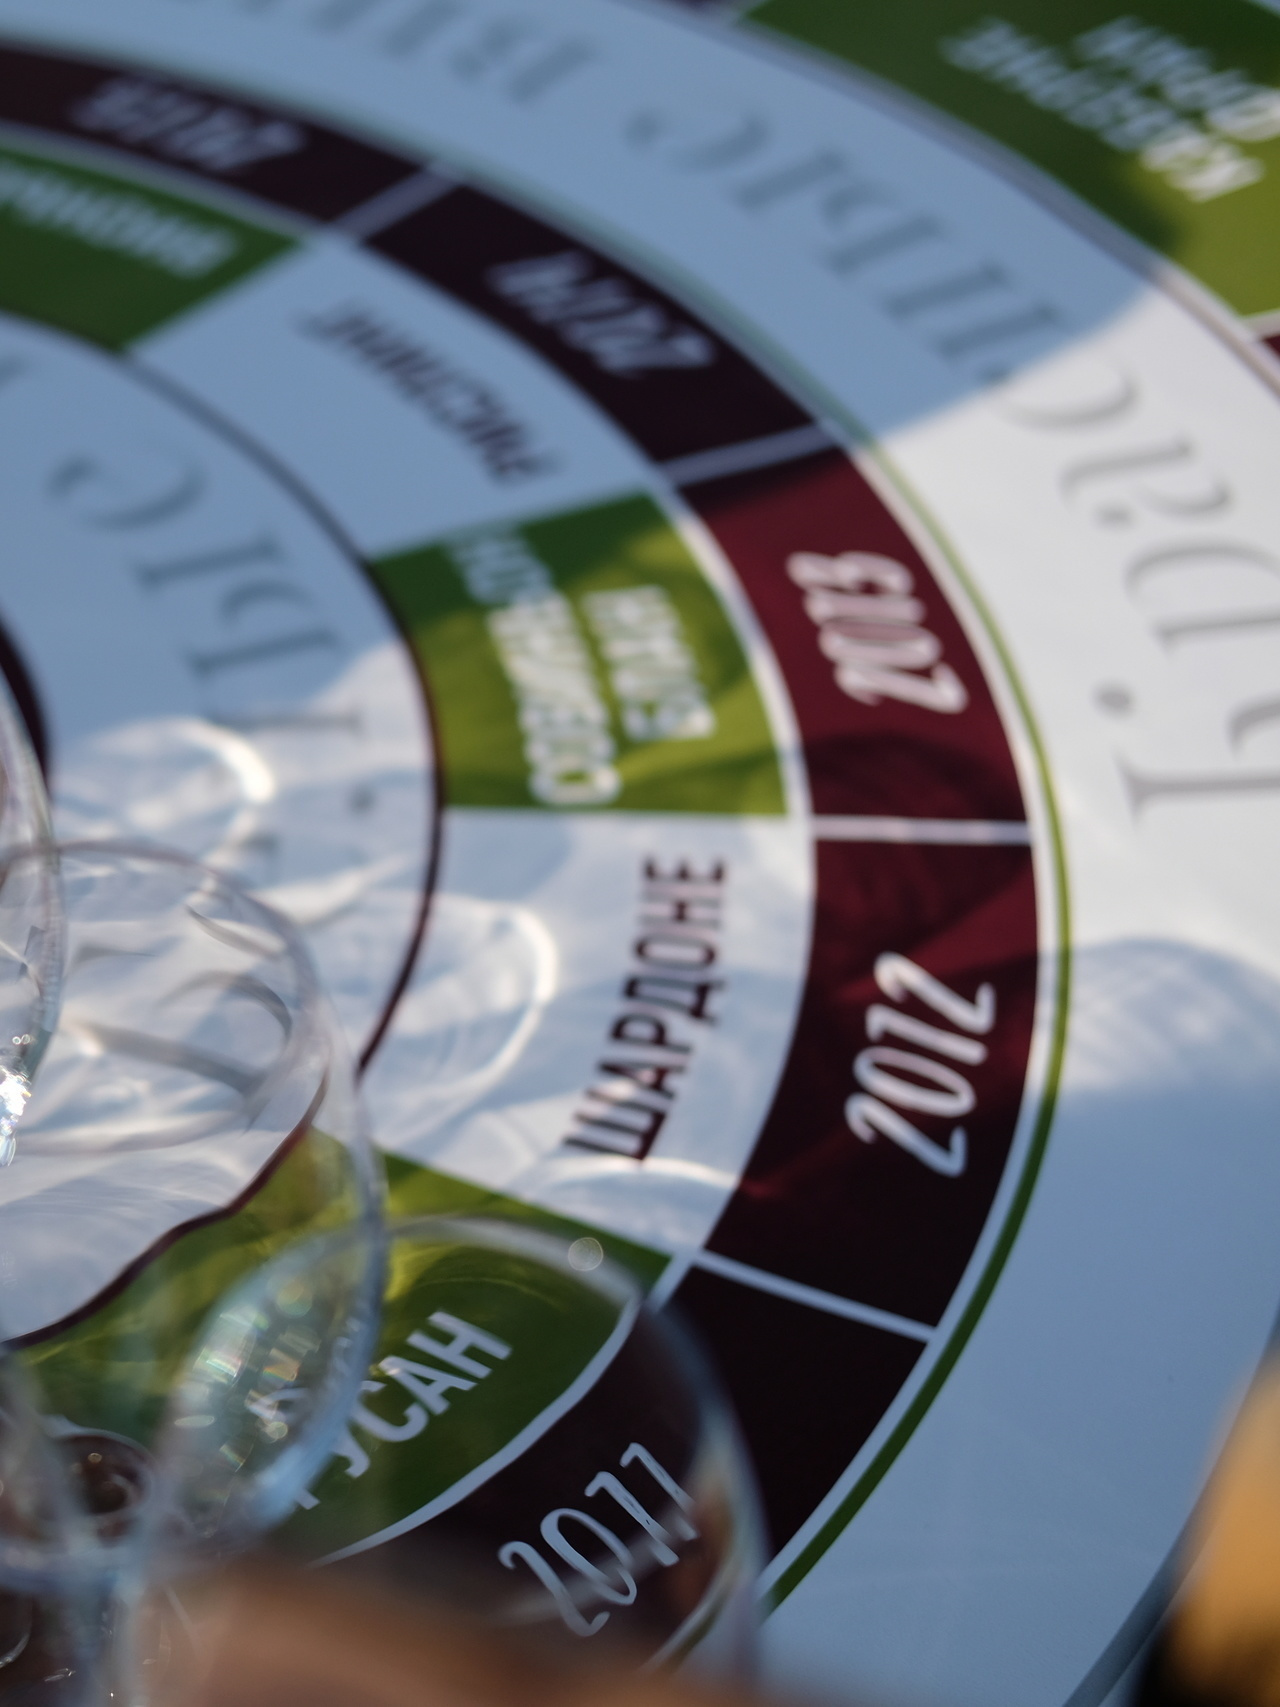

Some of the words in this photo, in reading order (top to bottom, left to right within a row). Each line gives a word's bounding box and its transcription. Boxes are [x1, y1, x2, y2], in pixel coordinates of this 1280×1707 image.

[787, 551, 968, 713] 2013
[561, 854, 727, 1167] ШАРДОНЕ
[845, 951, 996, 1178] 2012
[282, 1308, 513, 1510] УСАН
[497, 1441, 698, 1638] 2011
